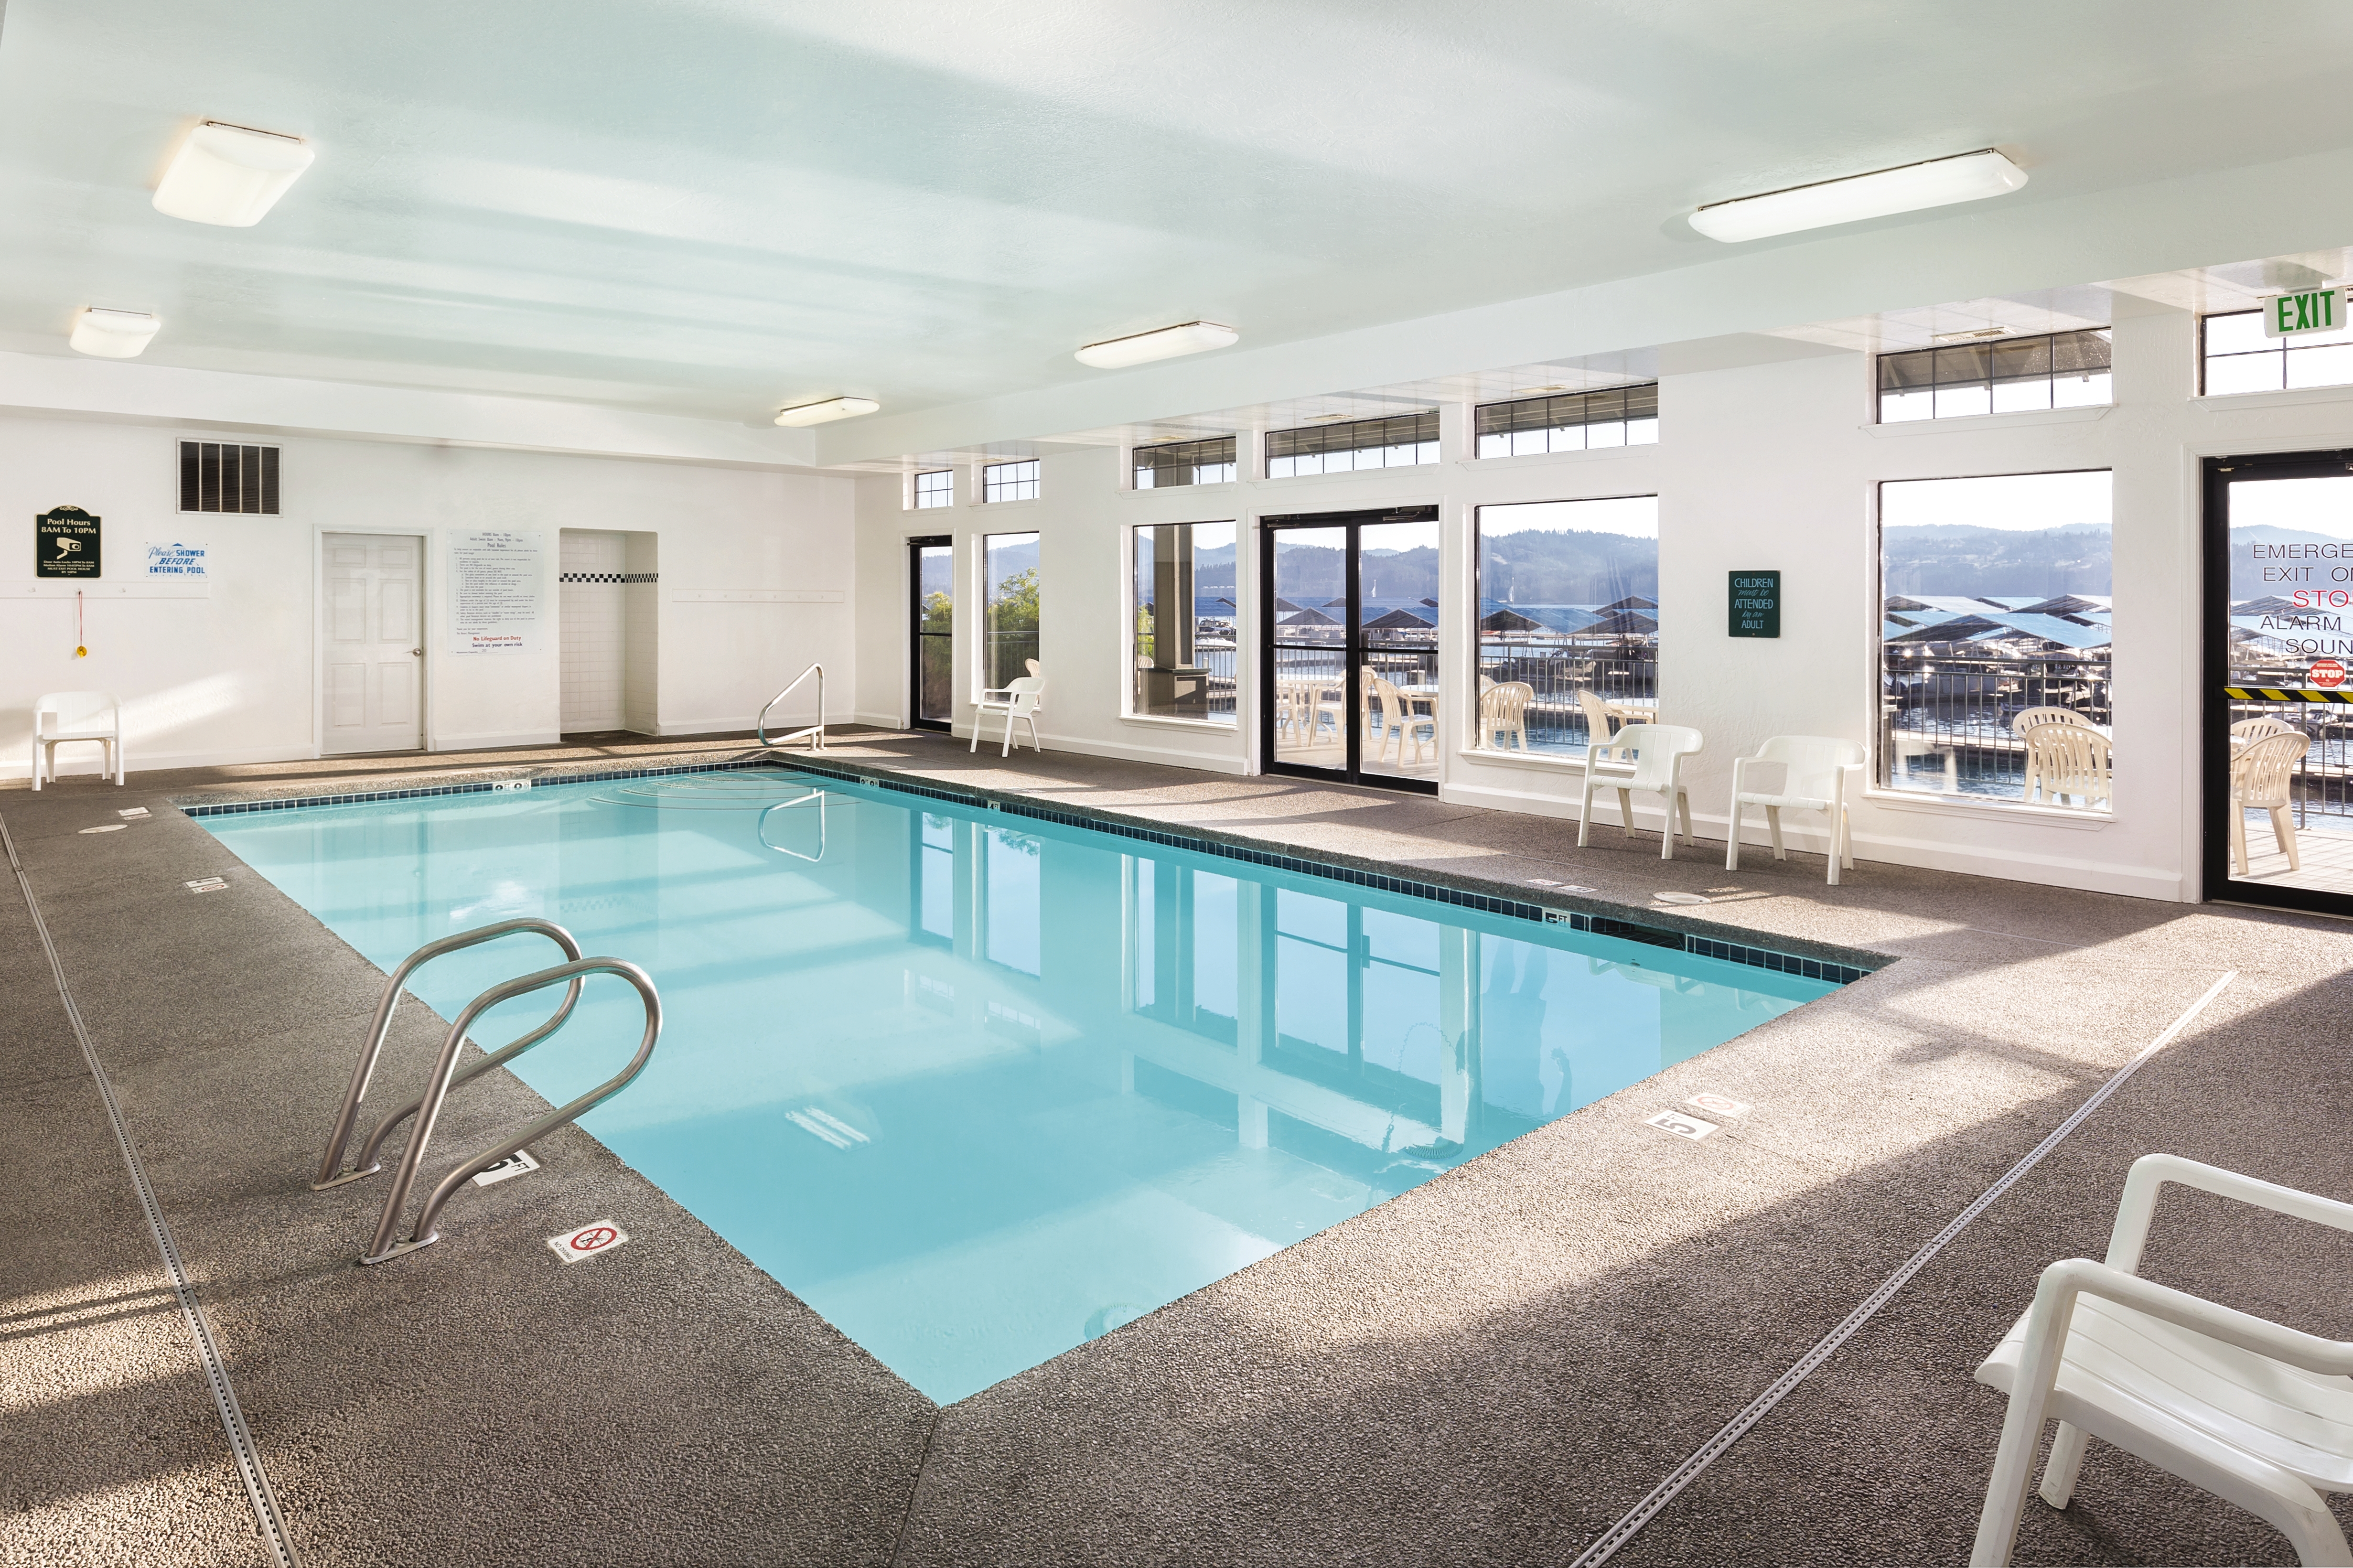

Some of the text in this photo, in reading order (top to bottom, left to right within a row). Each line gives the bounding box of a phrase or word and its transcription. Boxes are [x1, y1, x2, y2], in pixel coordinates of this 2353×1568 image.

[2278, 290, 2335, 332] EXIT
[149, 546, 174, 558] Please
[2253, 544, 2353, 558] EMERGE
[2264, 567, 2353, 582] EXIT O
[1734, 578, 1773, 588] CHILDREN
[1734, 599, 1773, 609] ATTENDED
[2293, 590, 2353, 608] STO
[1741, 610, 1752, 620] by
[1741, 620, 1764, 629] ADULT
[2260, 615, 2341, 631] ALARM
[2285, 639, 2353, 654] SOUN
[2311, 669, 2343, 678] STOP
[1654, 1118, 1697, 1134] 5
[511, 1162, 530, 1171] FT
